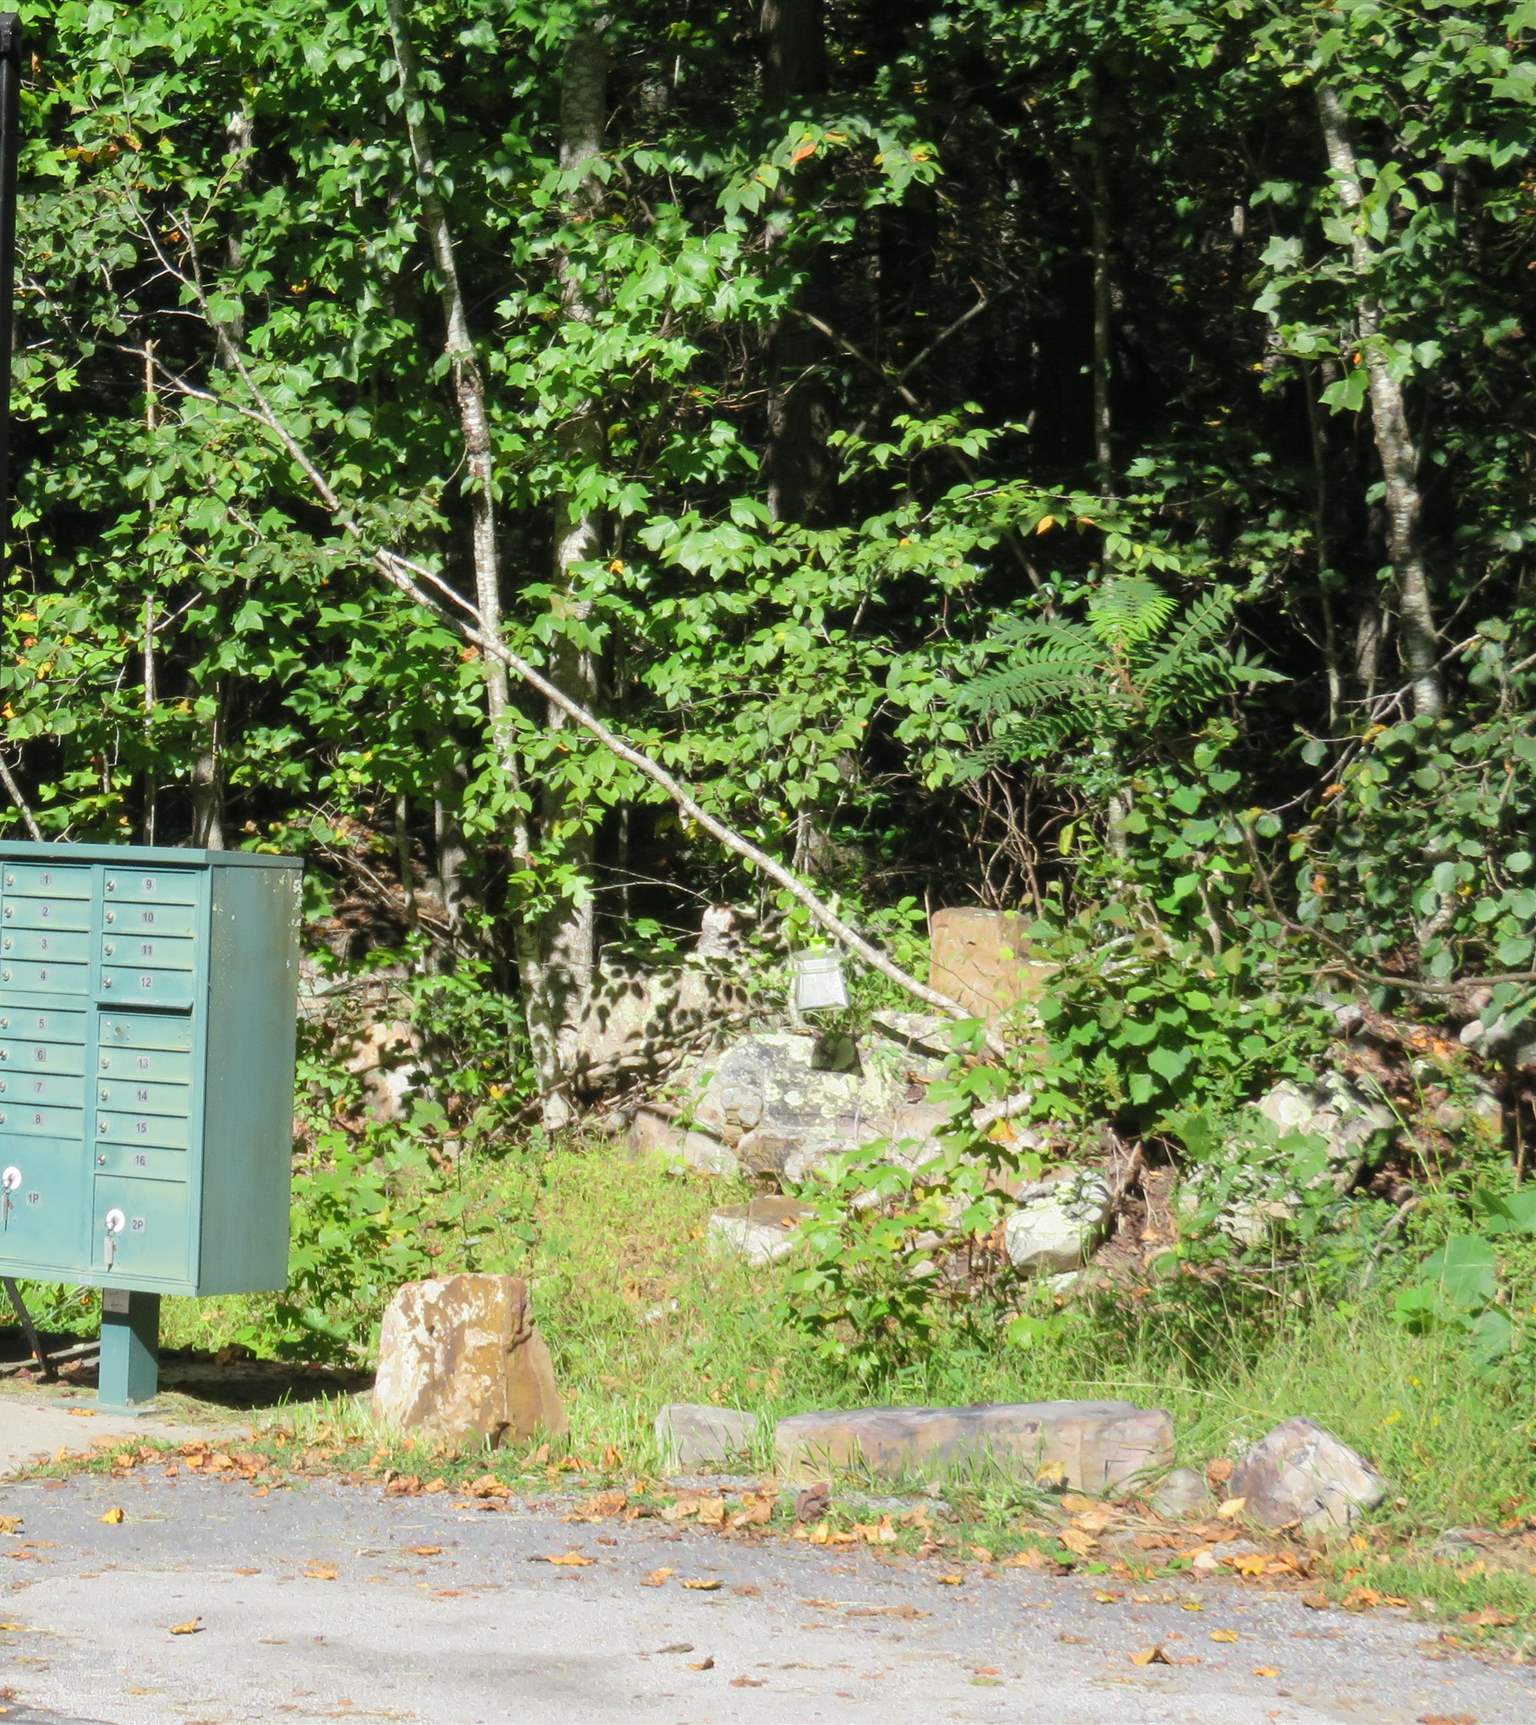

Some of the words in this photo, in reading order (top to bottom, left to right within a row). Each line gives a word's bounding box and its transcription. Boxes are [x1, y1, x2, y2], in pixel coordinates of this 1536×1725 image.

[145, 879, 152, 889] 9
[41, 907, 49, 917] 2
[143, 912, 154, 922] 10
[40, 939, 48, 949] 3
[142, 945, 152, 955] 11
[39, 970, 47, 981] 4
[141, 977, 152, 987] 12
[38, 1018, 45, 1029] 5
[139, 1059, 149, 1069] 13
[36, 1082, 43, 1092] 7
[137, 1091, 147, 1101] 14
[35, 1114, 42, 1124] 8
[136, 1123, 146, 1133] 15
[135, 1155, 146, 1166] 16
[28, 1193, 39, 1203] 1P
[132, 1220, 144, 1230] 2P
